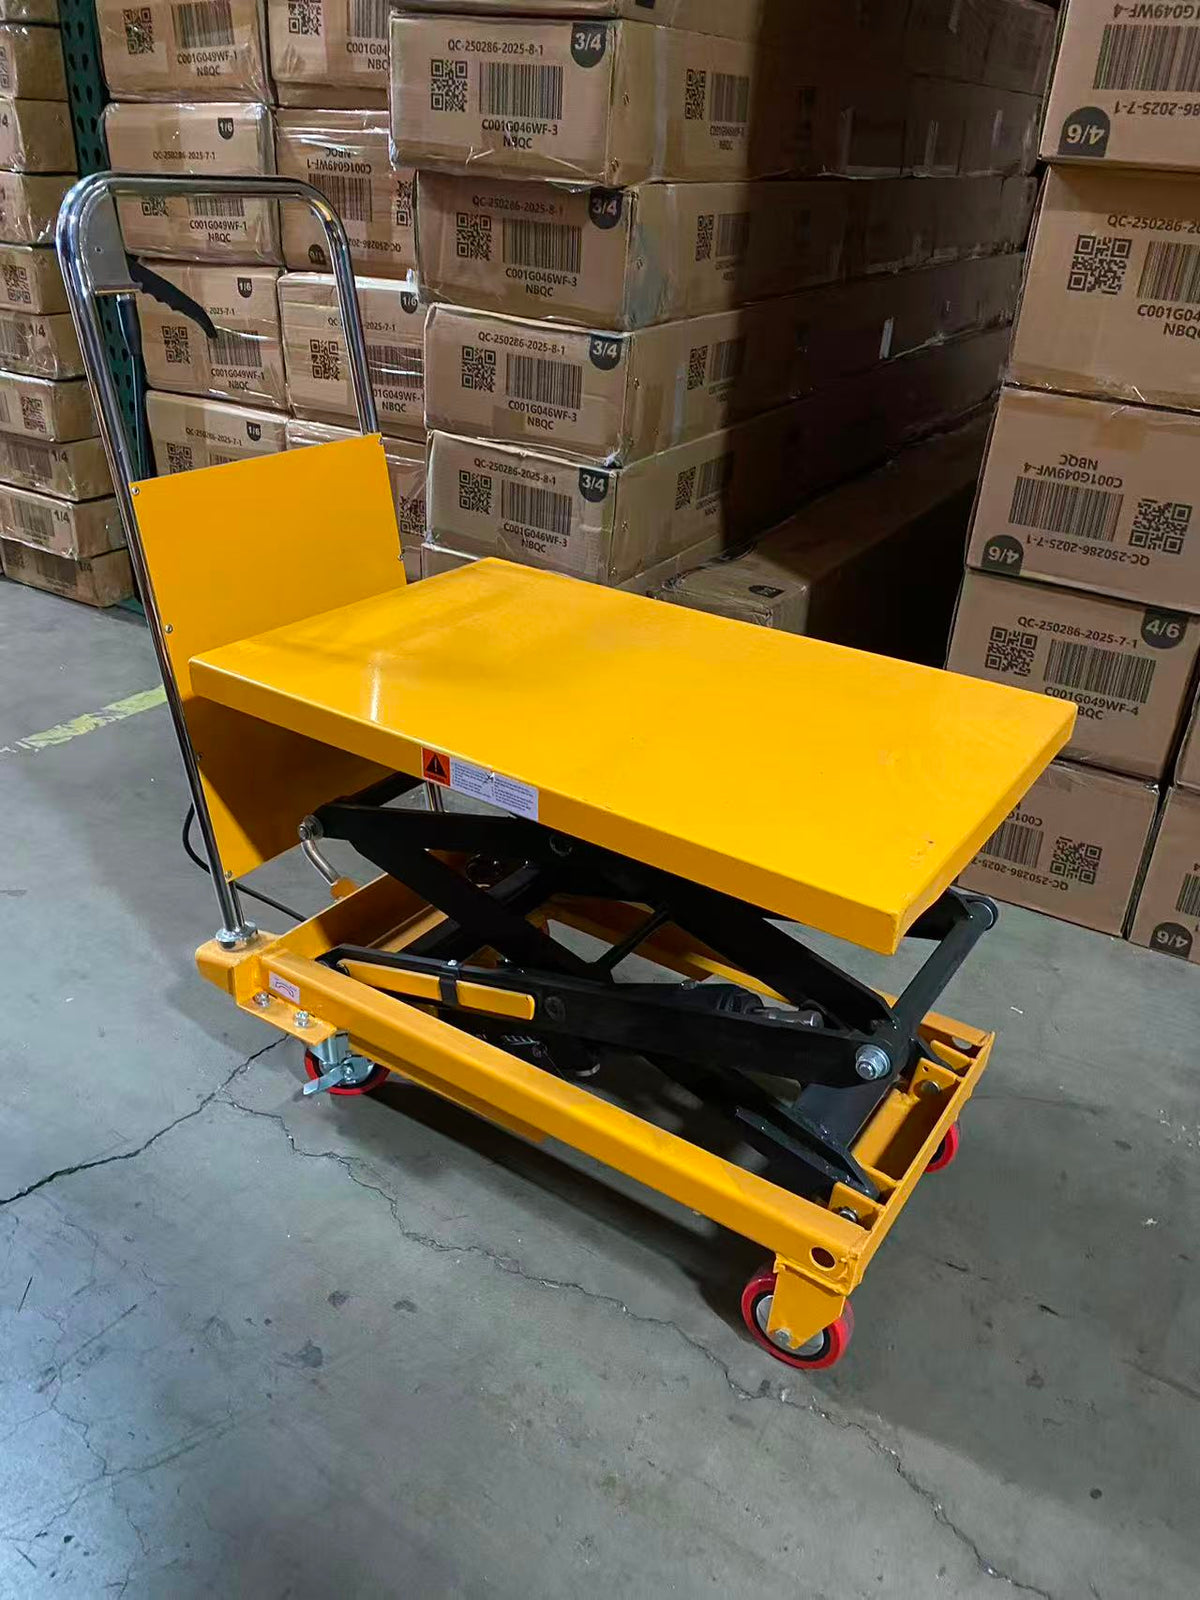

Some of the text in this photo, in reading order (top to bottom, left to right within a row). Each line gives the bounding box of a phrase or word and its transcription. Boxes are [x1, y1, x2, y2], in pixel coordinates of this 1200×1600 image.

[346, 41, 389, 55] C001G04
[448, 39, 544, 57] QC-250286-2025-8-1
[574, 32, 602, 50] 3/4
[219, 121, 233, 133] 1/6
[482, 119, 558, 136] C001G046WF-3
[1067, 124, 1104, 144] 4/6
[503, 136, 533, 150] NBQC
[190, 220, 248, 231] C001G049WF-1
[505, 267, 577, 287] C001G046WF-3
[526, 283, 553, 297] NBQC
[403, 296, 417, 306] 1/6
[478, 331, 565, 355] QC-250286-2025-8-1
[593, 341, 616, 358] 3/4
[381, 401, 407, 412] NBQC
[508, 400, 577, 422] C001G046WF-3
[527, 416, 554, 430] NBQC
[474, 457, 556, 486] QC-250286-2025-8-1
[1059, 454, 1098, 471] NBQC
[582, 474, 605, 491] 3/4
[1024, 461, 1123, 489] C001G049WF-4
[504, 522, 567, 548] C001G046WF-3
[521, 538, 546, 553] NBQC
[1026, 534, 1150, 566] QC-250286-2025-7-1
[988, 546, 1019, 564] 4/6
[1017, 616, 1138, 647] QC-250286-2025-7-1
[1145, 620, 1180, 638] 4/6
[1044, 686, 1139, 716] C001G049WF-4
[1077, 705, 1104, 720] BQC
[1156, 930, 1188, 948] 4/6
